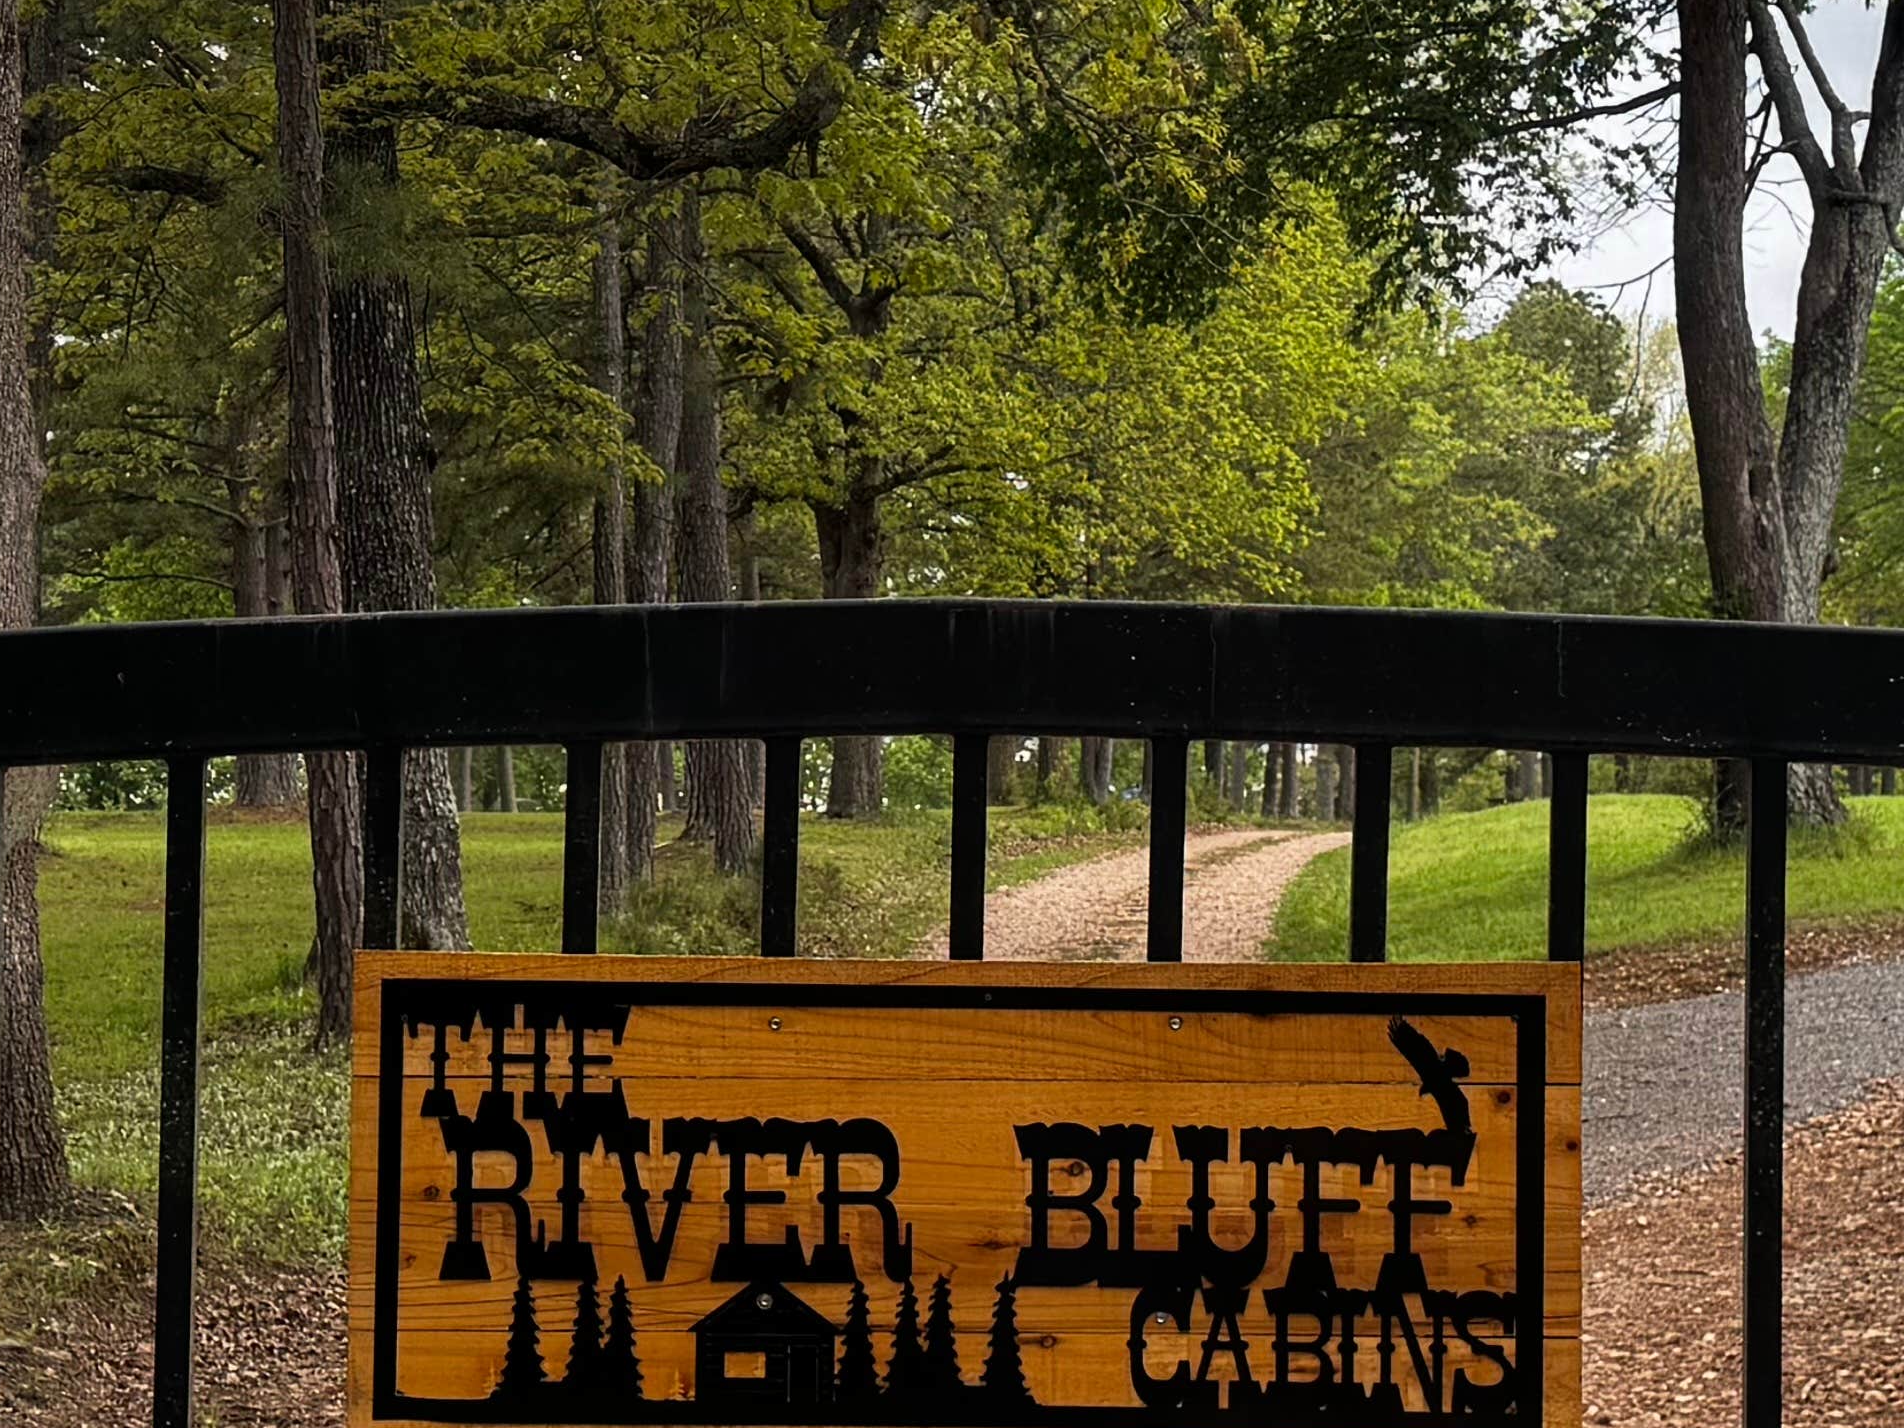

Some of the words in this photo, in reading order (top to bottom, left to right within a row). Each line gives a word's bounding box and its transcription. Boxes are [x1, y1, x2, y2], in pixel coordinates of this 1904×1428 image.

[402, 1005, 630, 1118] THE
[439, 1117, 912, 1282] RIVER
[1013, 1123, 1477, 1292] BLUFF
[1128, 1285, 1518, 1417] CABINS
